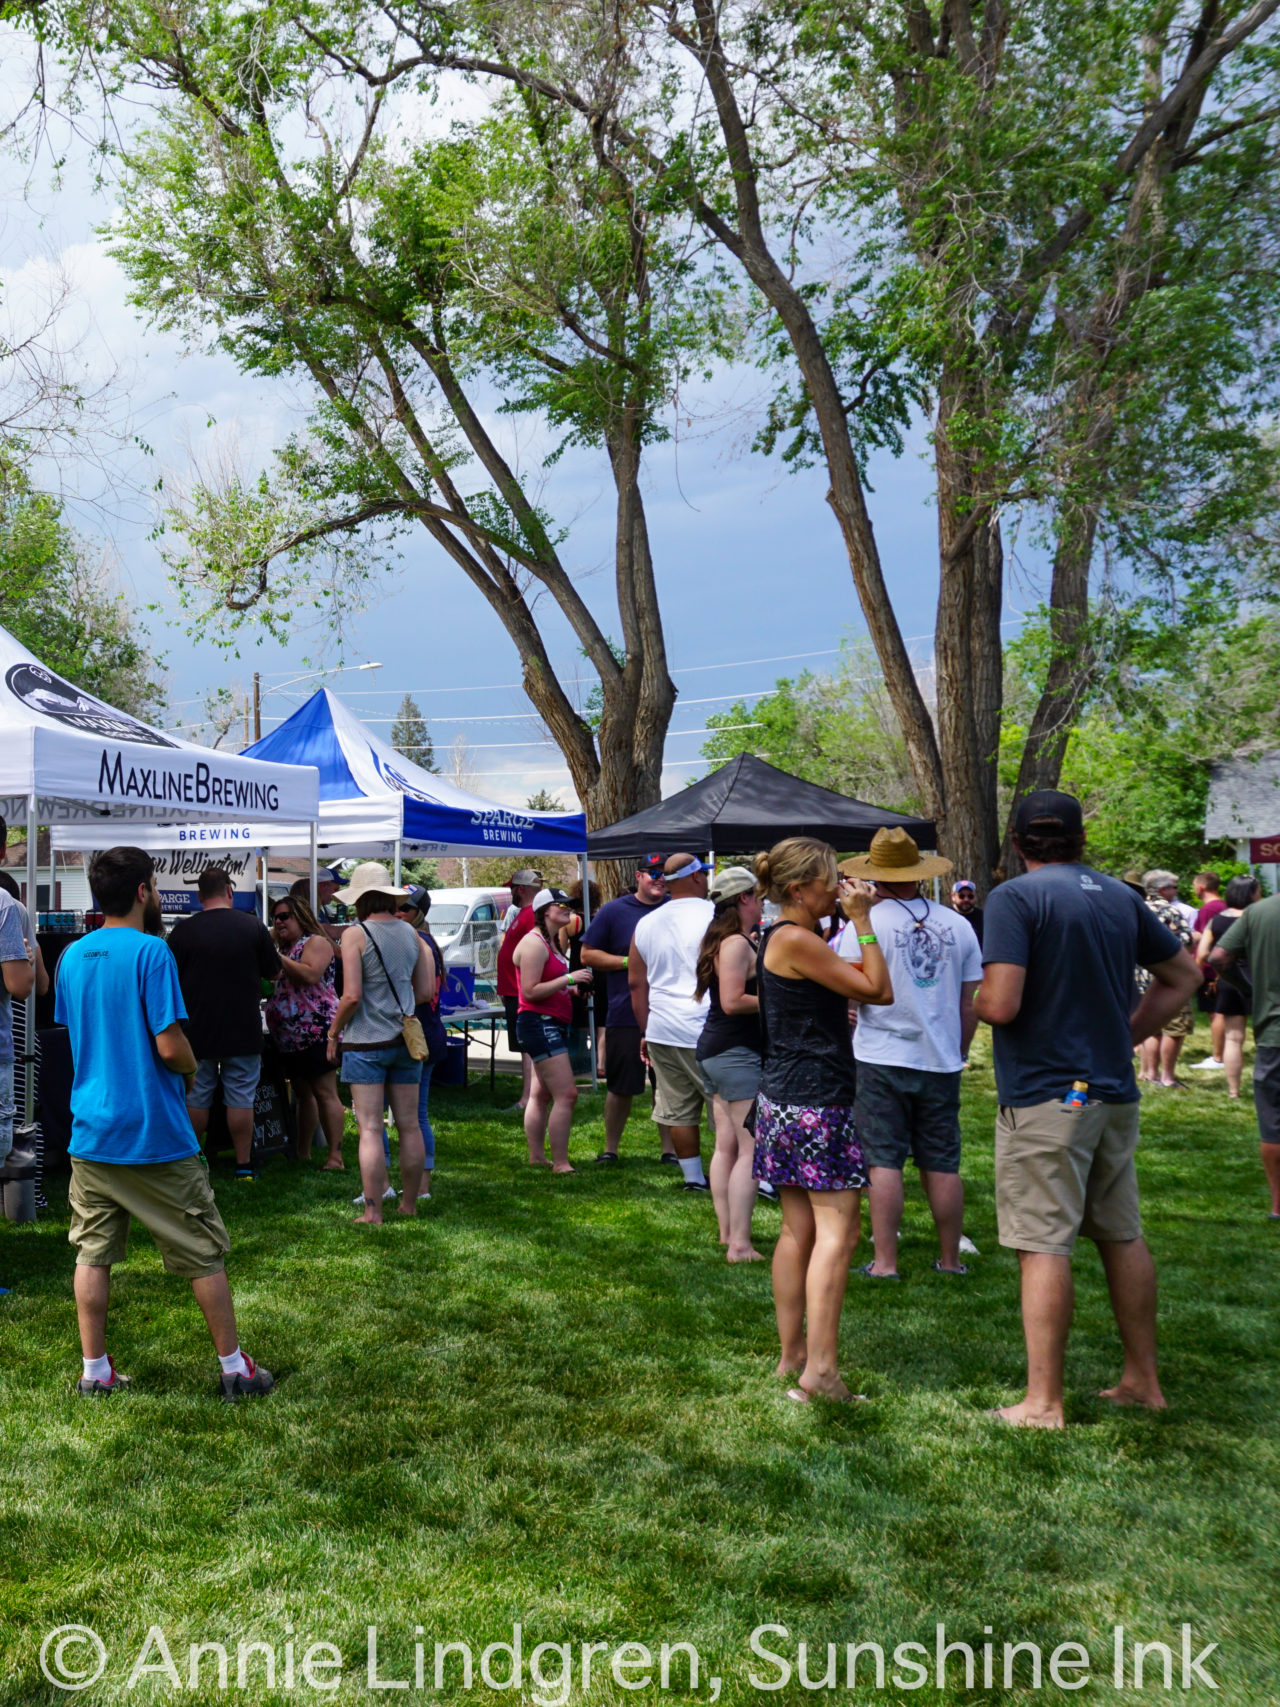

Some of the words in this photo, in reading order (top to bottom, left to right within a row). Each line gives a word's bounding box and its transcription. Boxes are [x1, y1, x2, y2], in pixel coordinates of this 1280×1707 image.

[179, 828, 250, 841] BREWING
[483, 828, 523, 844] BREWING
[159, 893, 190, 904] PARGE
